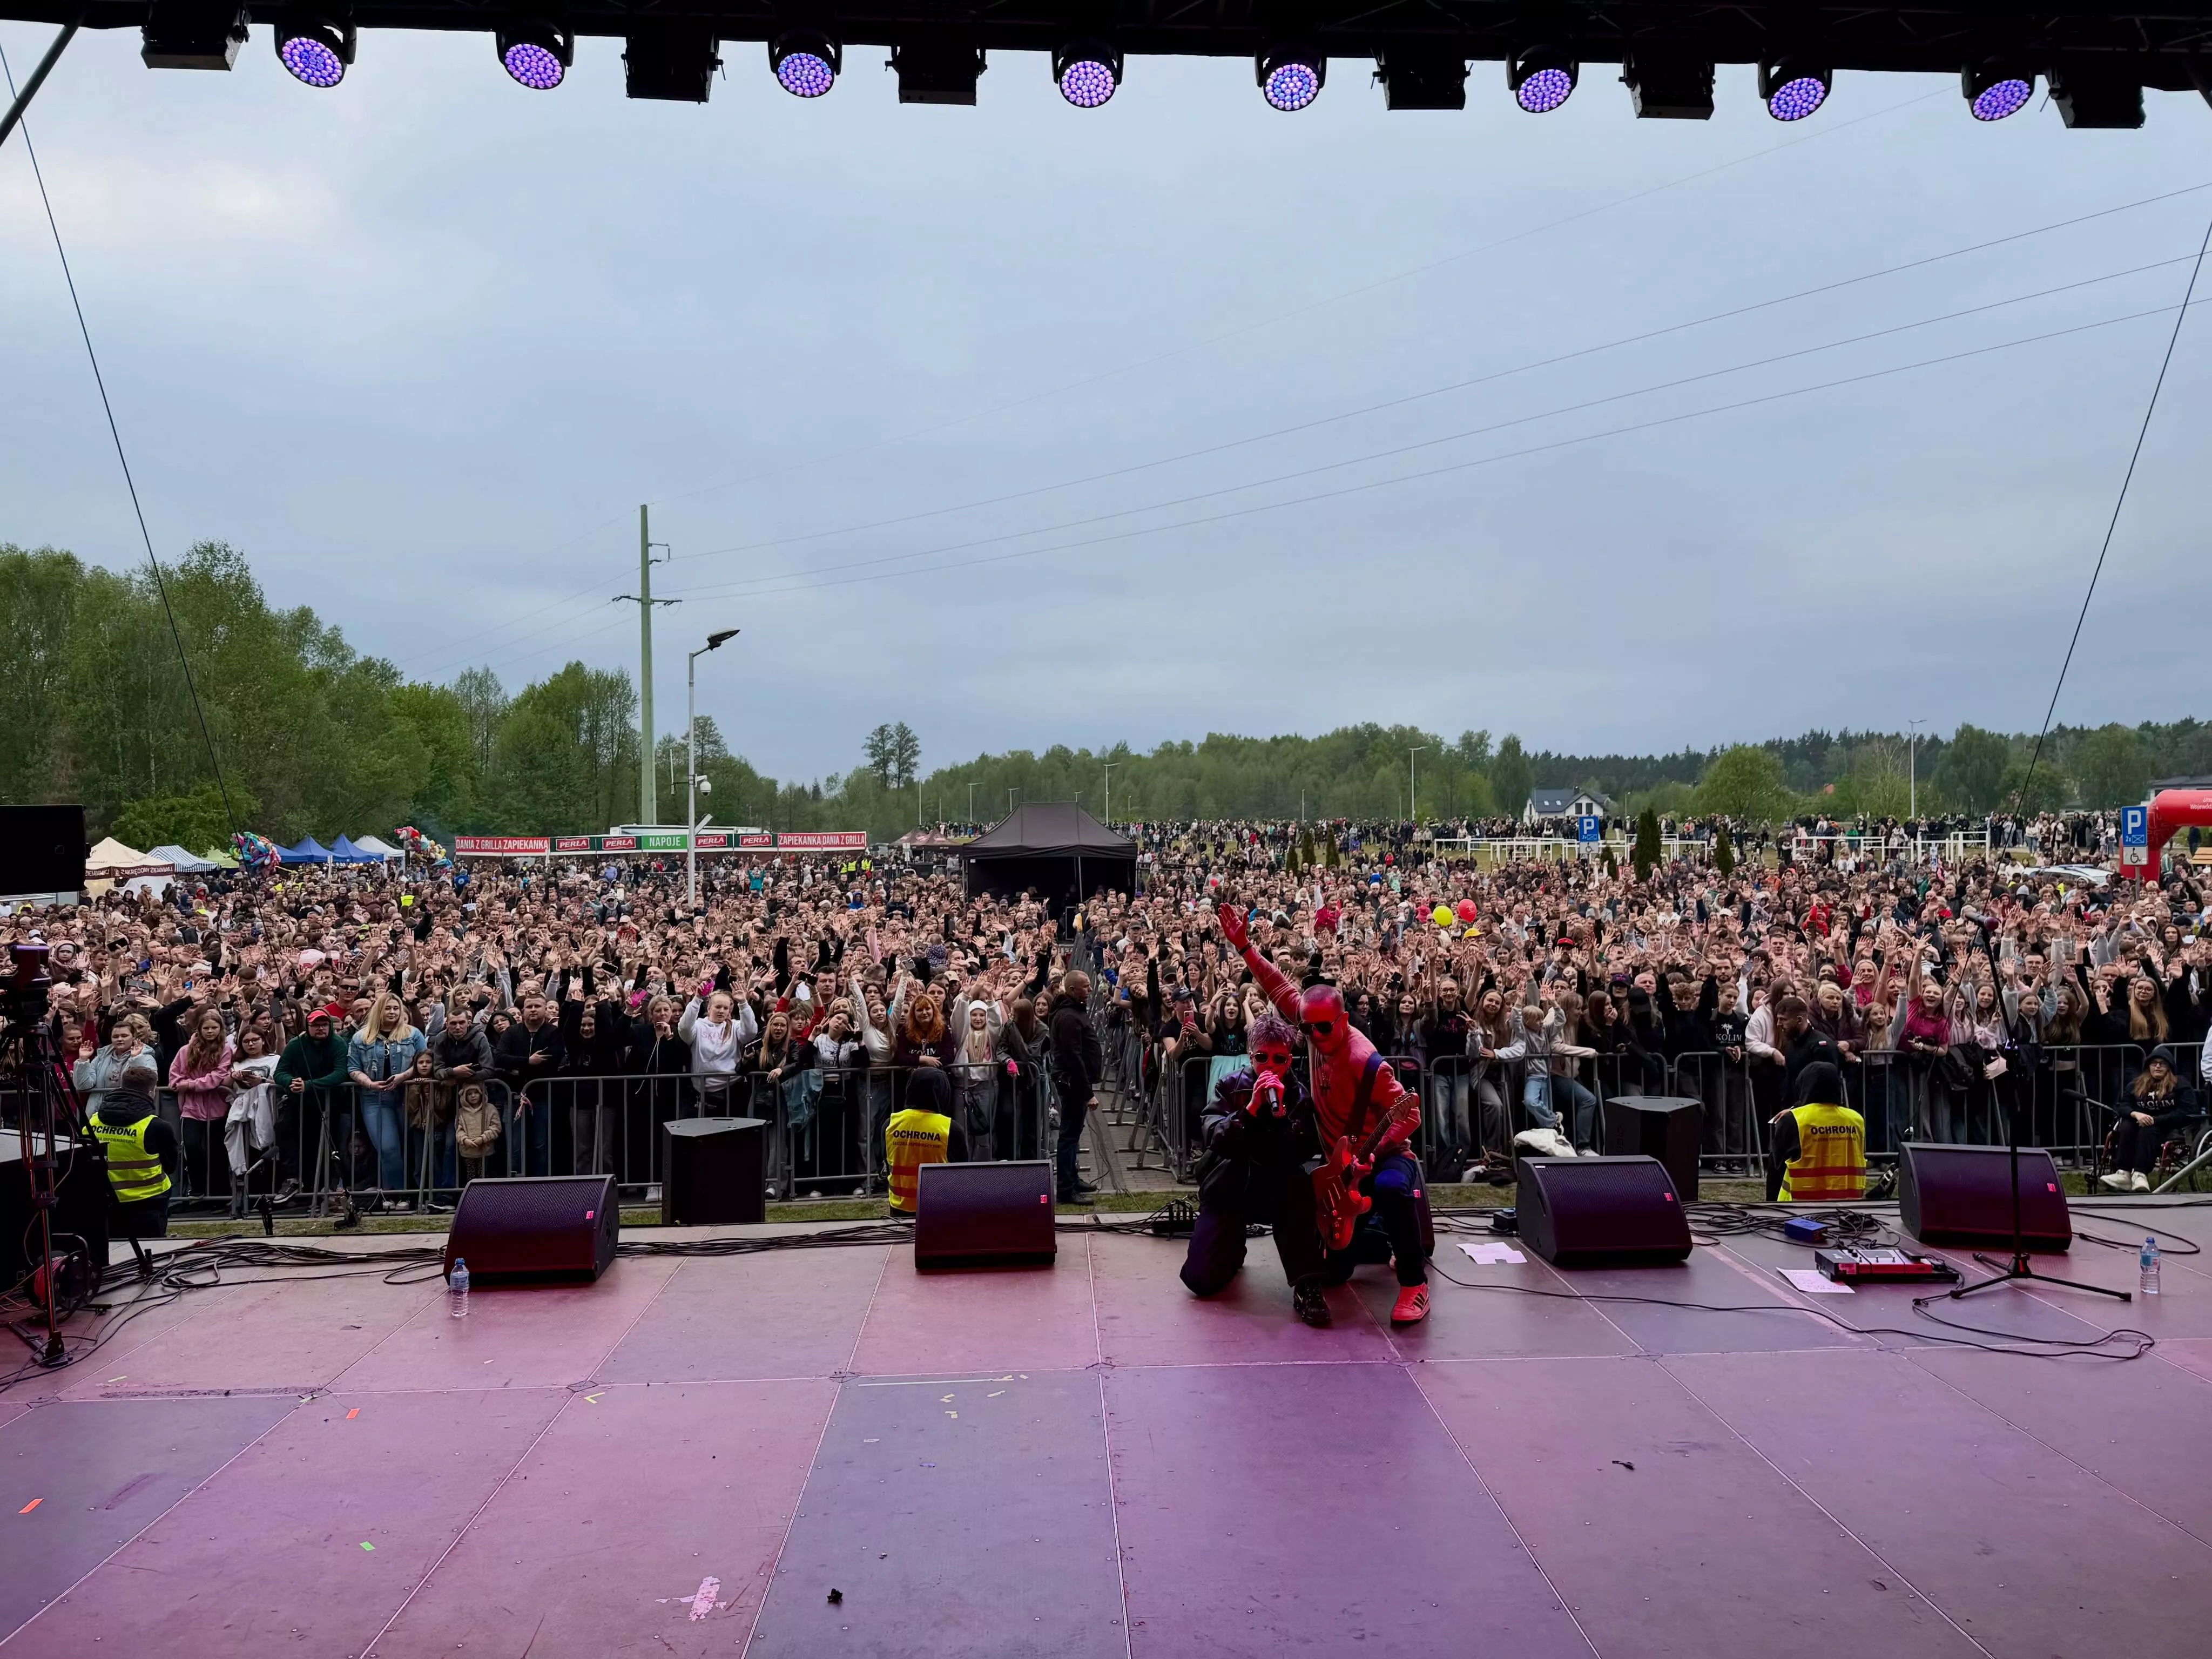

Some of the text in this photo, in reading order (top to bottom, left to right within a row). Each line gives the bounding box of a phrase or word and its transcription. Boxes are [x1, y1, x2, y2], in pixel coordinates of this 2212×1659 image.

[1583, 819, 1595, 834] P
[2127, 810, 2142, 834] P
[456, 839, 502, 849] DANIA Z GRILLA
[503, 840, 549, 849] ZAPIEKANKA
[559, 840, 587, 848] PERŁA
[605, 839, 633, 847] PERŁA
[649, 837, 680, 847] NAPOJE
[698, 837, 724, 845] PERŁA
[743, 837, 769, 845] PERŁA
[779, 835, 821, 845] ZAPIEKANKA
[822, 834, 864, 845] DANIA Z GRILLA
[91, 1125, 137, 1137] OCHRONA
[1811, 1125, 1856, 1135] OCHRONA
[893, 1130, 941, 1141] OCHRONA
